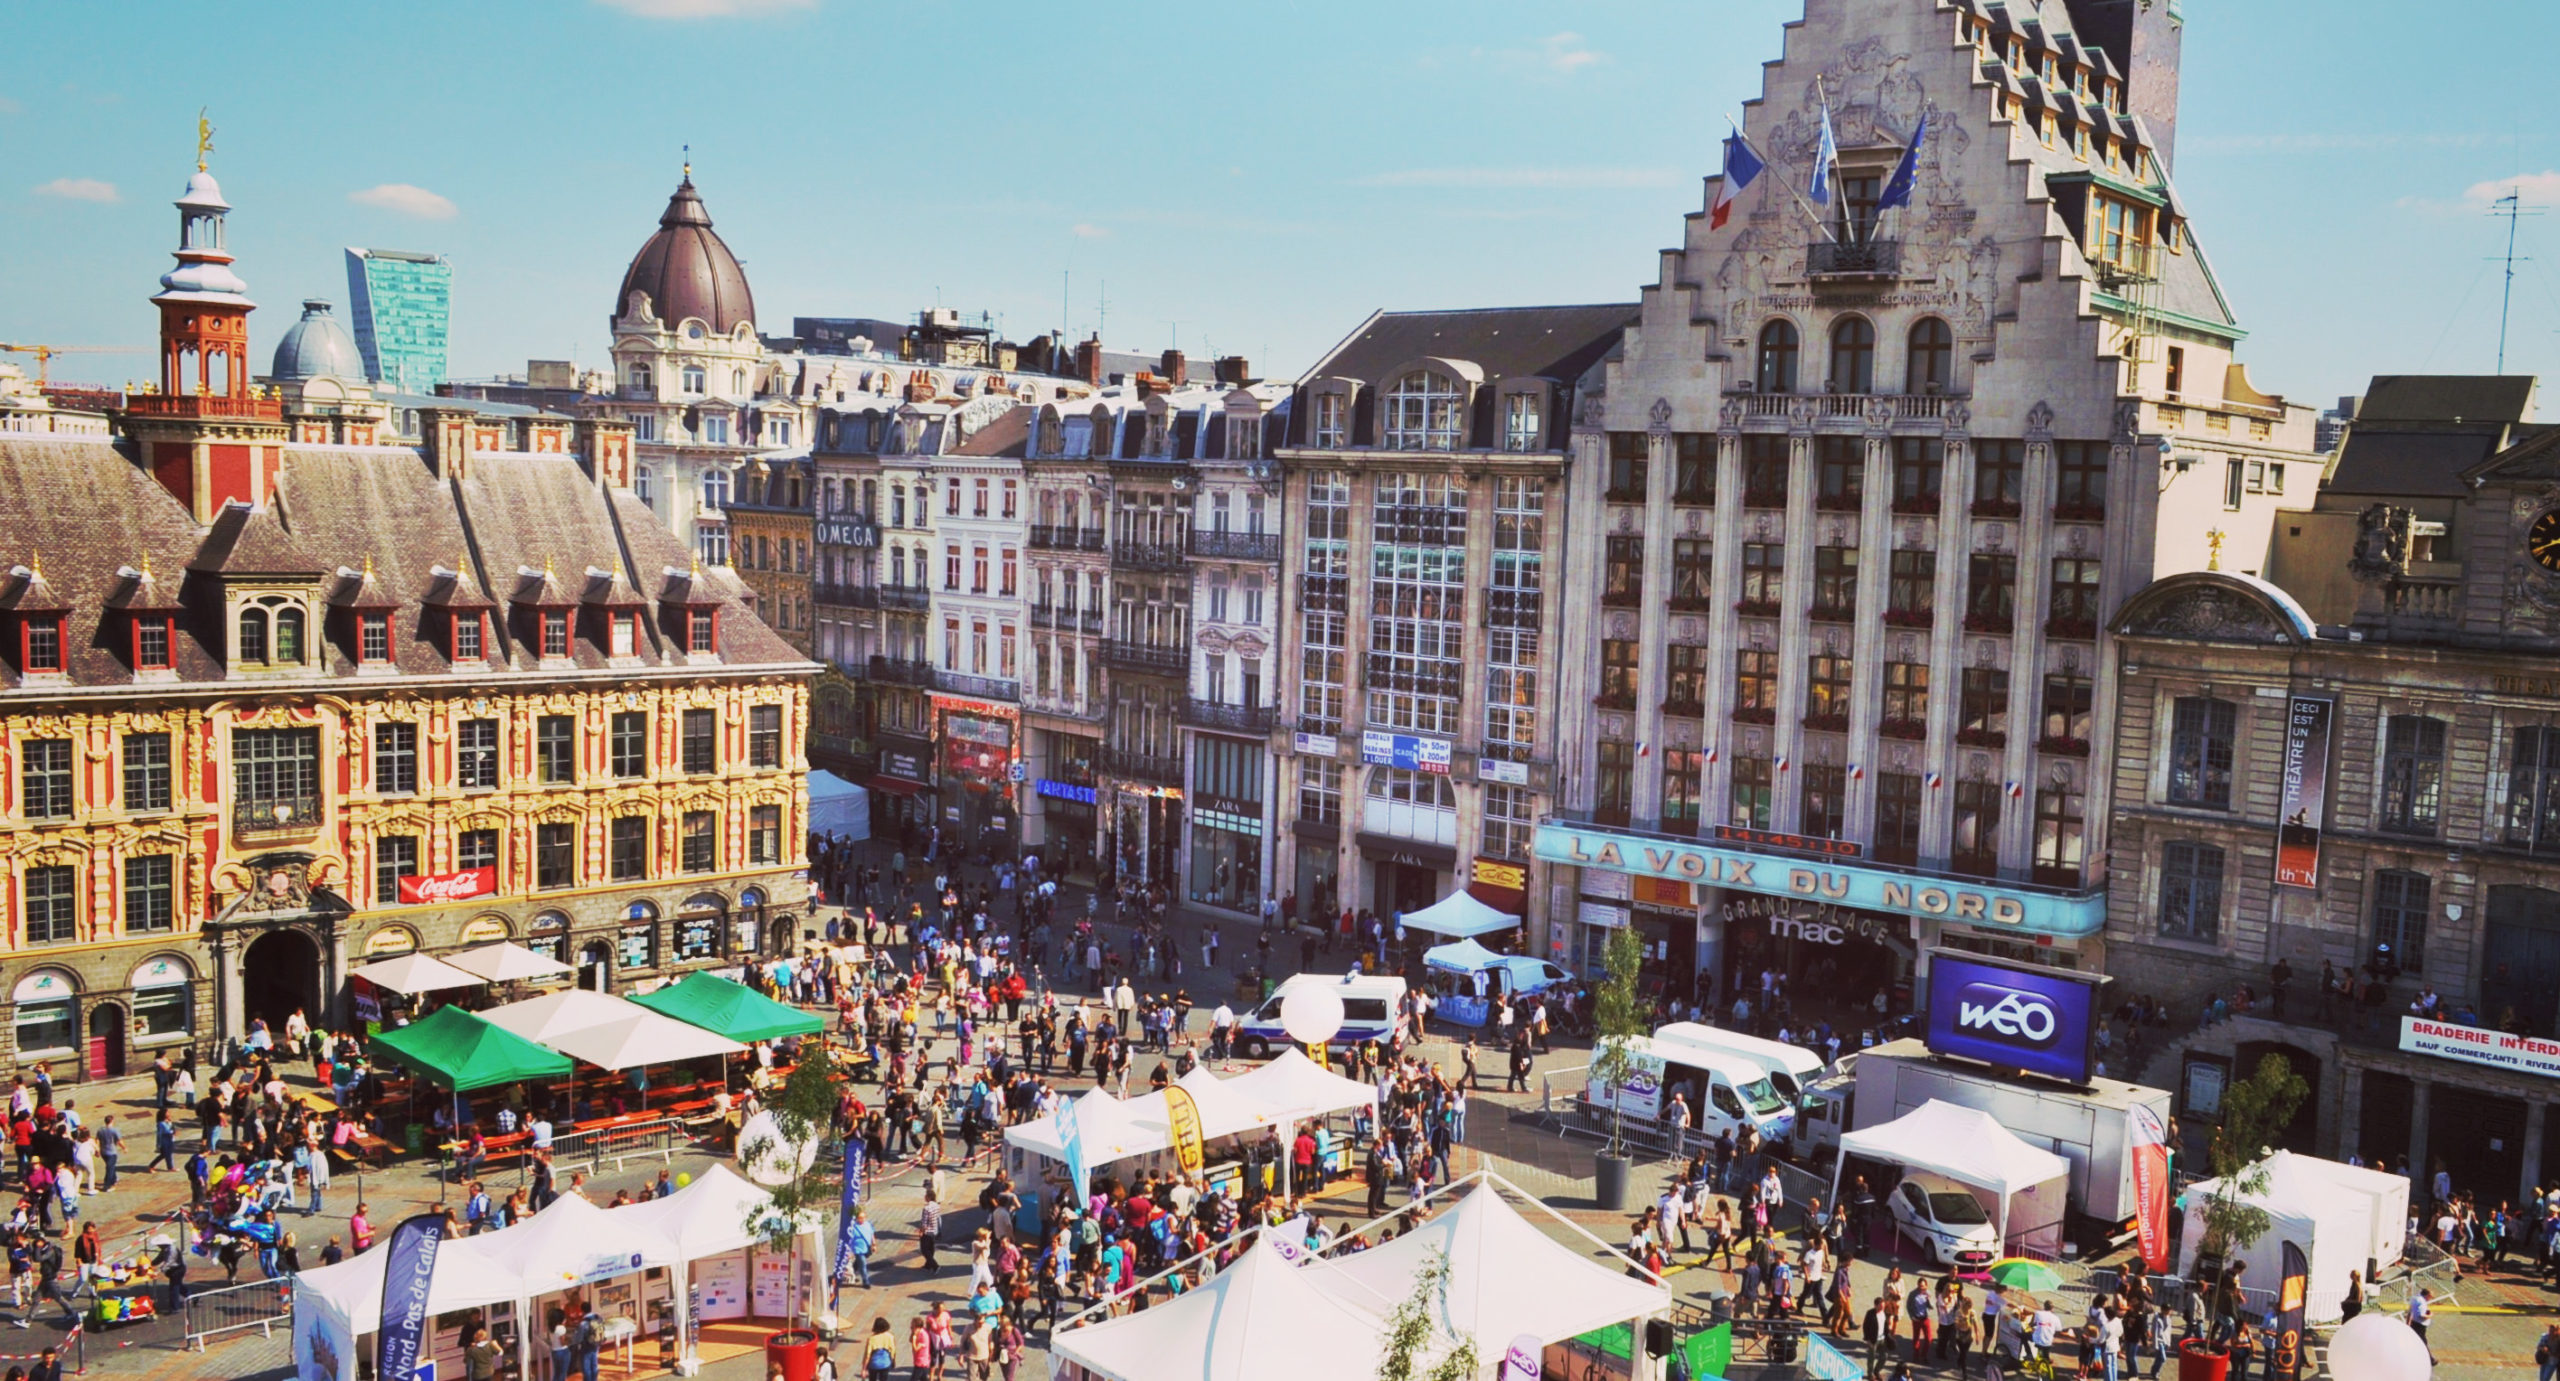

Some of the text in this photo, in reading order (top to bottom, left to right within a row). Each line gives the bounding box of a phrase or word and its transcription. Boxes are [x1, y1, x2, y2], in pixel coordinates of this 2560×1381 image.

[817, 522, 874, 547] OMEGA
[2294, 702, 2320, 714] CECI
[2292, 726, 2309, 737] UN
[2293, 715, 2314, 726] EST
[1370, 755, 1392, 765] LOUER
[1037, 780, 1097, 804] FANTASTI
[1214, 800, 1240, 813] ZARA
[1721, 828, 1855, 855] 14:45:10
[1392, 853, 1422, 866] ZARA
[1569, 836, 1624, 866] LA
[1644, 847, 1755, 886] VOIX
[1789, 868, 1849, 898] DU
[1883, 882, 2025, 925] NORD
[1632, 901, 1697, 918] Notting Hill Coffee
[1768, 915, 1845, 946] fnac
[1817, 902, 1888, 946] PLACE
[1959, 992, 2055, 1041] wéo
[2412, 1021, 2560, 1057] BRADERIE INTERD
[2415, 1040, 2439, 1051] SAUF
[2444, 1045, 2518, 1065] COMMERÇANTS
[414, 1226, 439, 1276] Calais
[409, 1277, 427, 1299] de
